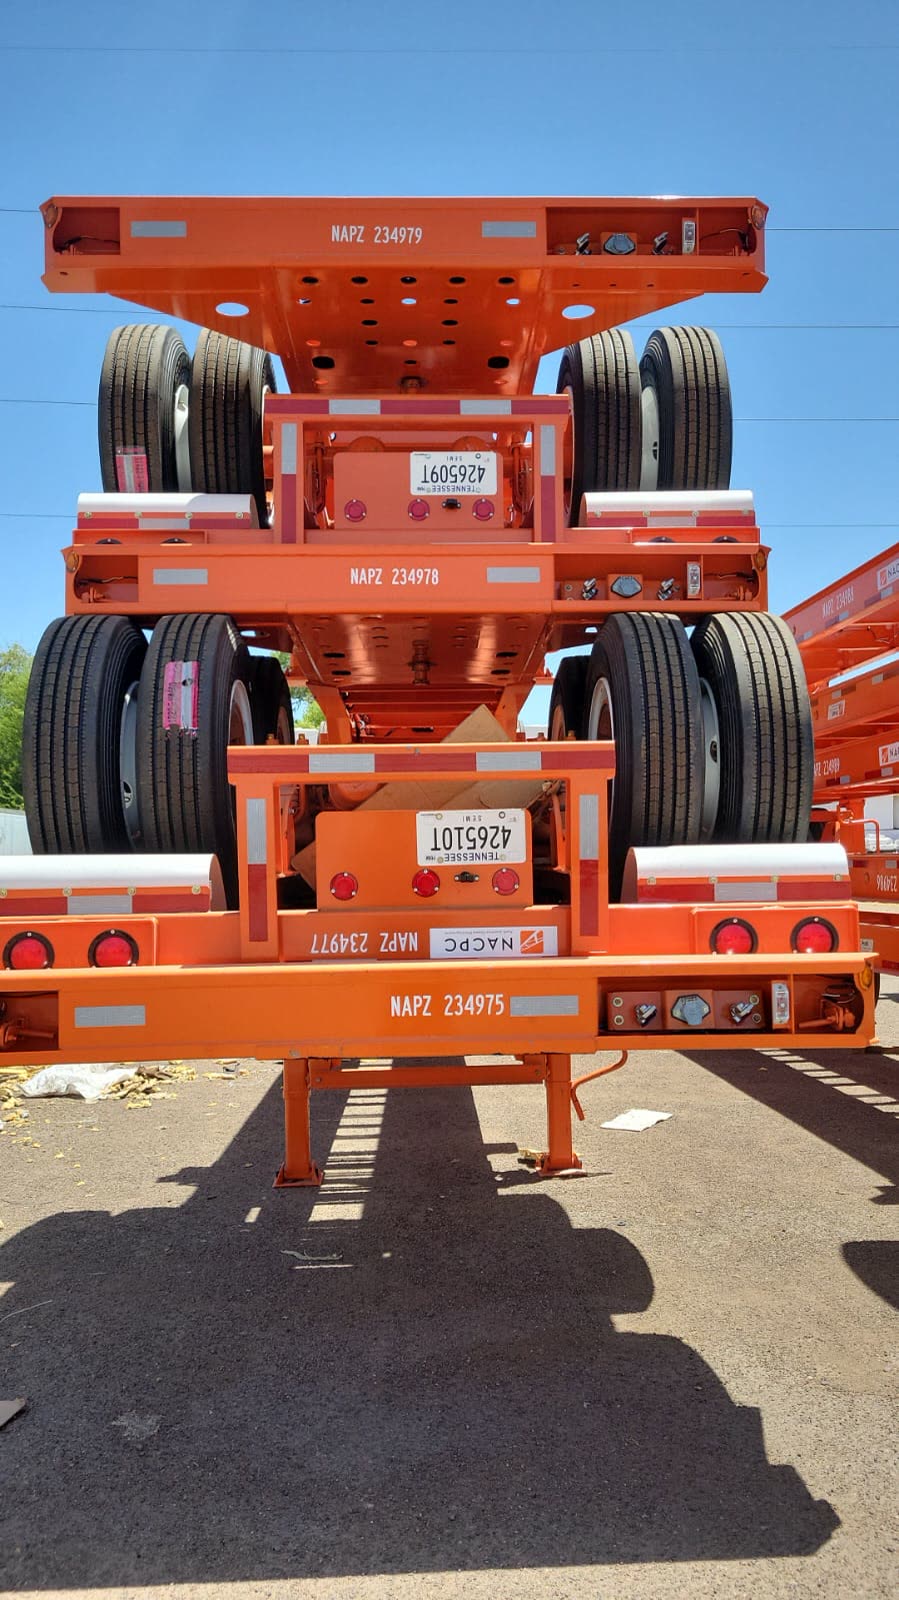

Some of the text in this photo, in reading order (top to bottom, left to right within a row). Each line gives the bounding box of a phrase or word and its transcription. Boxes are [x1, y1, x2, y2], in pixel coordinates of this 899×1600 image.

[331, 224, 423, 244] NAPZ 234979
[421, 464, 486, 484] 426509T
[431, 485, 475, 493] TENNESSEE
[350, 567, 439, 585] NAPZ 234978
[431, 825, 512, 851] 426510T
[444, 851, 500, 862] TENNESSEE
[310, 932, 418, 954] NAPZ 234977
[444, 937, 513, 952] NACPC
[390, 994, 504, 1017] NAPZ 234975
